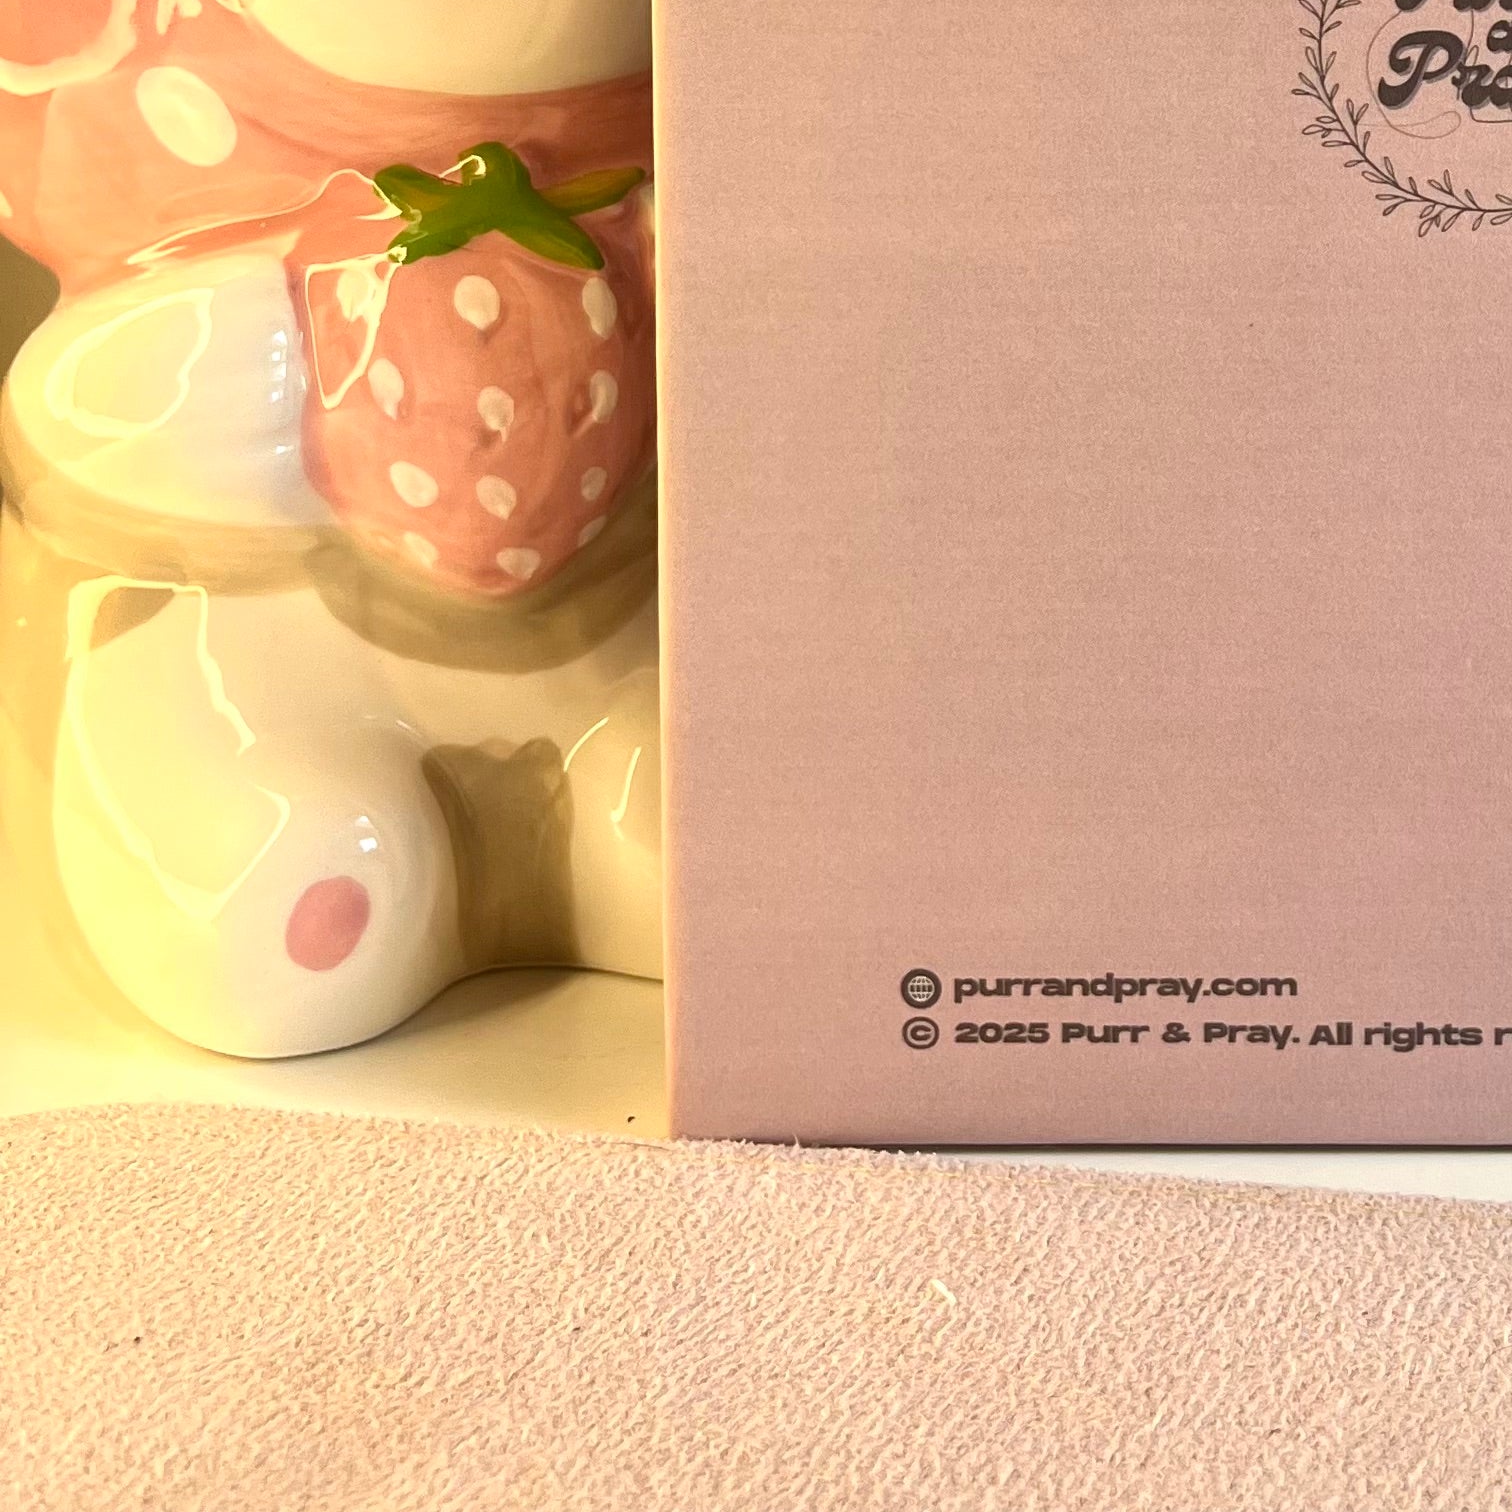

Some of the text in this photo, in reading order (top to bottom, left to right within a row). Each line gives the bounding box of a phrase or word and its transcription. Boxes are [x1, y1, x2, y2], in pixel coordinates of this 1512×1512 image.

[954, 973, 1297, 1003] purrandpray.com
[955, 1023, 1049, 1043] 2025
[1062, 1023, 1149, 1043] Purr
[1162, 1023, 1191, 1043] &
[1204, 1023, 1300, 1050] Pray.
[1309, 1023, 1352, 1045] All
[1364, 1022, 1482, 1052] rights
